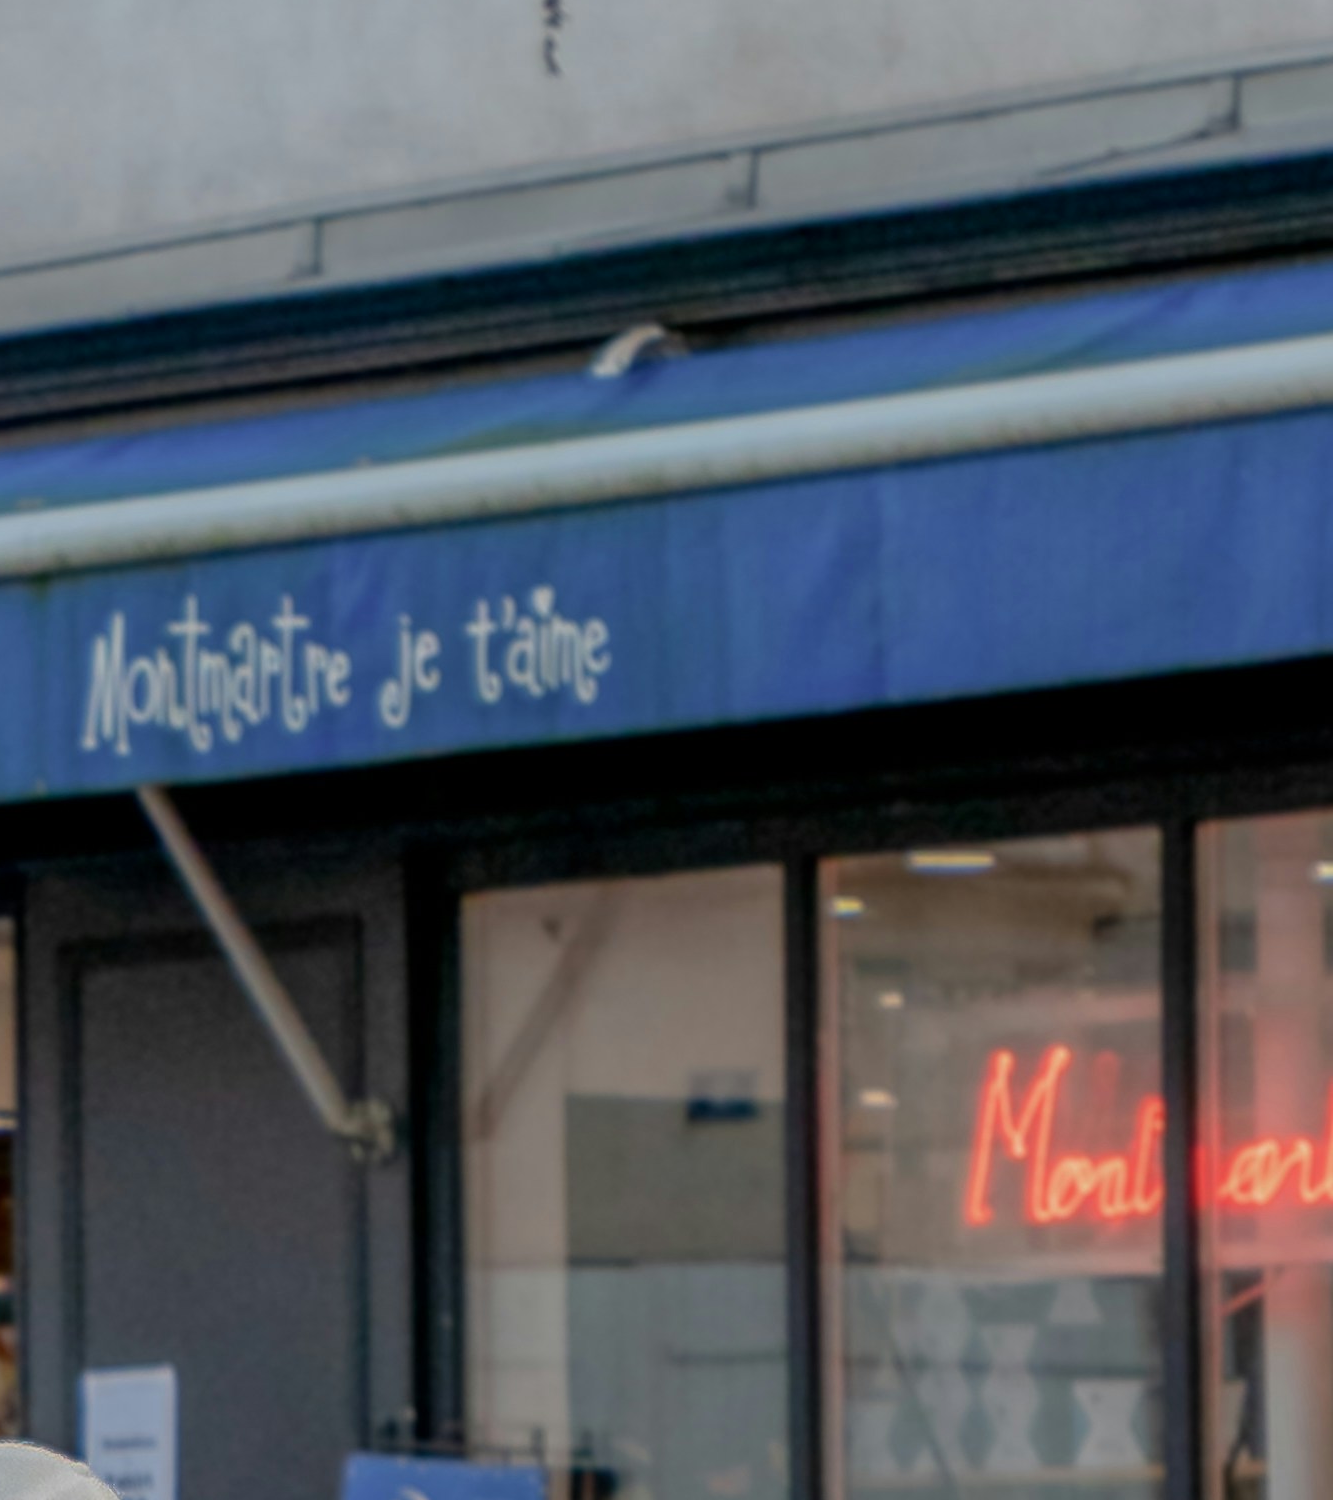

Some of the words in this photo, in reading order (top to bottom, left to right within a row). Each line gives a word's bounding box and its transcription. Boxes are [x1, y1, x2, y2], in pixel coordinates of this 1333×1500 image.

[80, 594, 351, 756] Montmartre
[379, 614, 440, 729] je
[466, 585, 612, 705] t'aime
